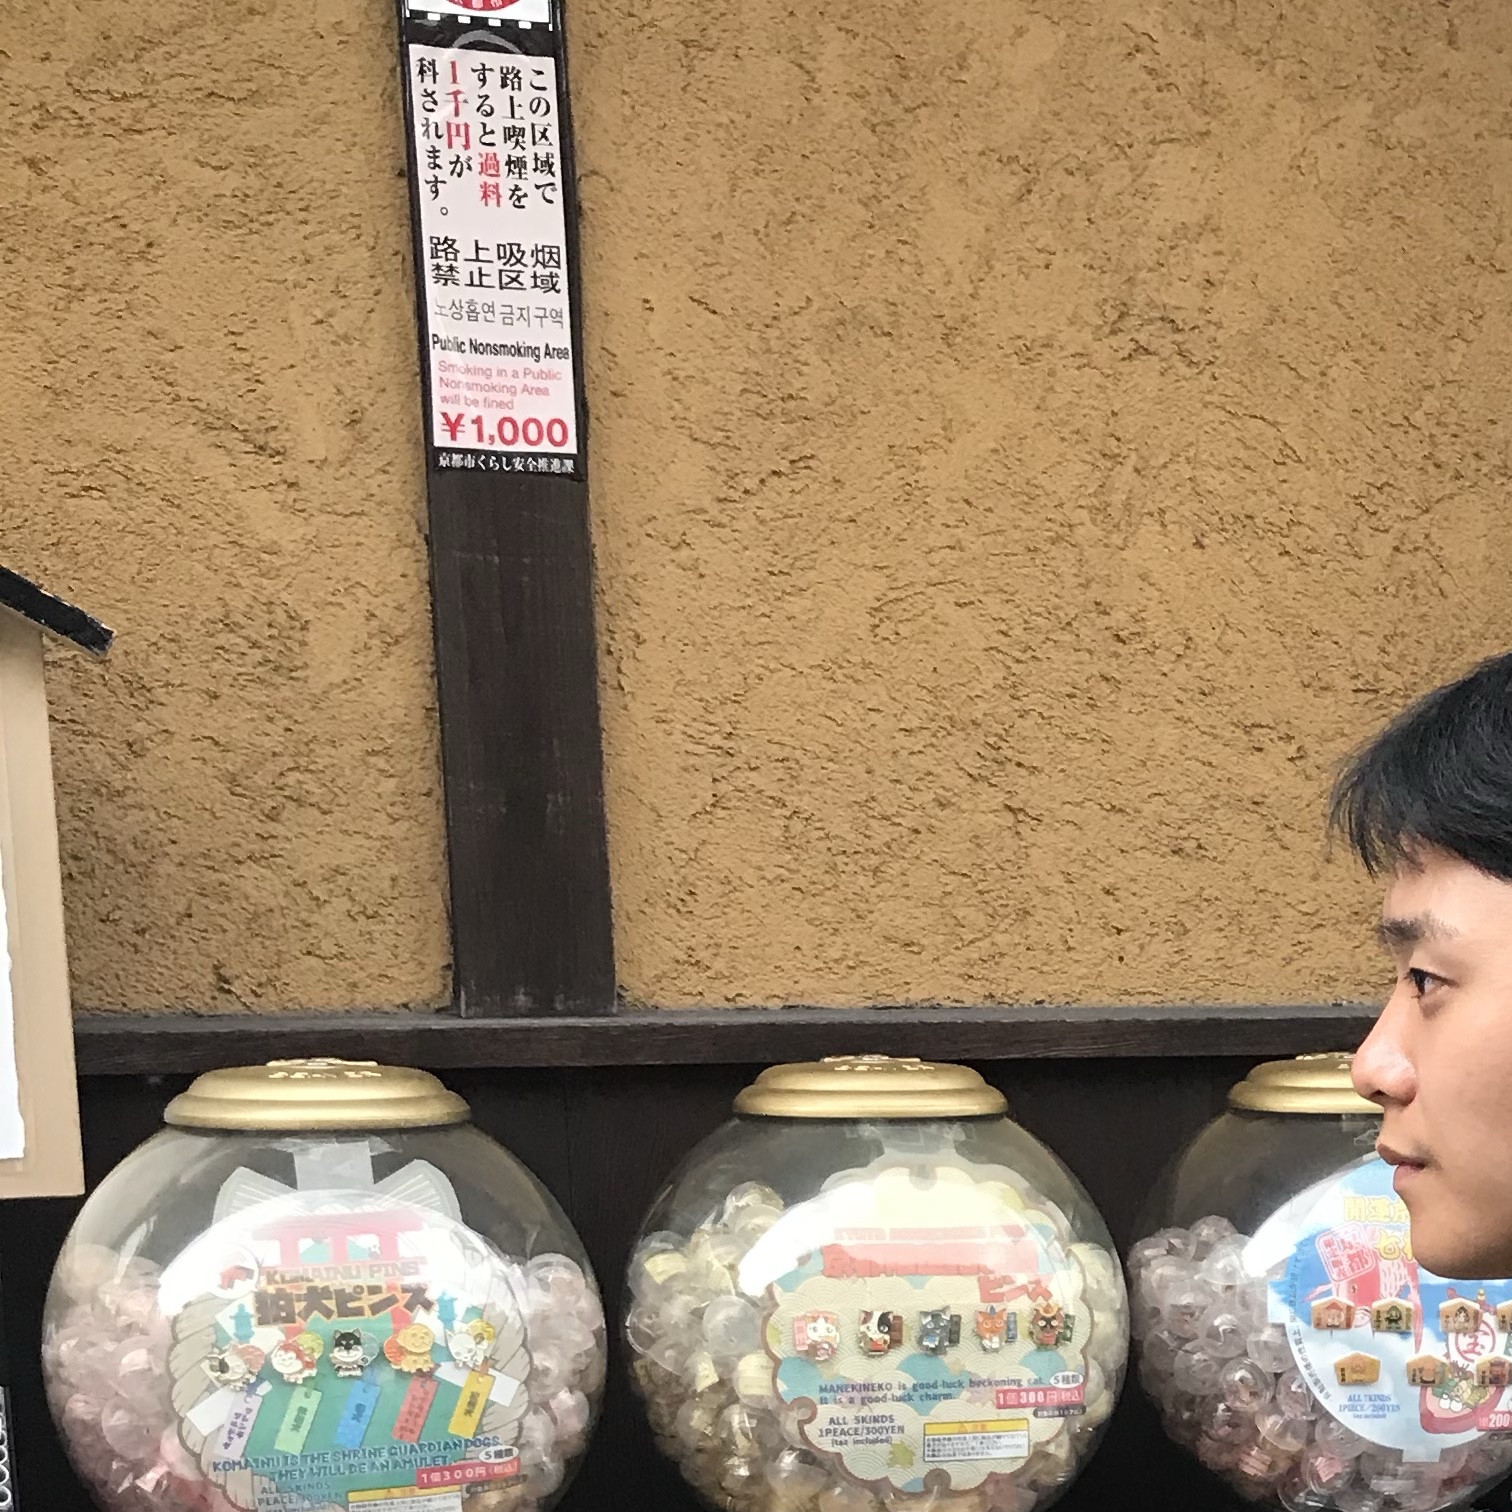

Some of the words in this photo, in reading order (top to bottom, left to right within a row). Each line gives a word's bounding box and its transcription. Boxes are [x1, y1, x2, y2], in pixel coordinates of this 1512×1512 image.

[416, 57, 449, 216] 科されます。
[471, 63, 502, 208] すると過料
[499, 65, 529, 209] 路上喫煙を
[529, 68, 558, 204] この区域で
[430, 236, 561, 270] 路上吸烟
[432, 263, 561, 294] 禁止区域
[434, 298, 496, 323] 노상흡연
[500, 304, 564, 329] 금지구역
[432, 333, 466, 354] Public
[469, 338, 541, 363] Nonsmoking
[544, 343, 570, 360] Area
[438, 361, 492, 380] Smoking
[497, 365, 508, 377] in
[512, 369, 520, 379] a
[523, 367, 562, 381] Public
[439, 377, 517, 397] Nonsmoking
[522, 383, 550, 396] Area
[440, 394, 461, 407] will
[464, 395, 480, 408] be
[483, 397, 514, 411] fined
[440, 411, 569, 447] ¥1,000
[369, 1261, 419, 1279] PINS
[829, 1416, 848, 1425] ALL
[302, 1452, 329, 1464] THE
[333, 1448, 386, 1463] SHRINE
[388, 1439, 462, 1456] GUARDIAN
